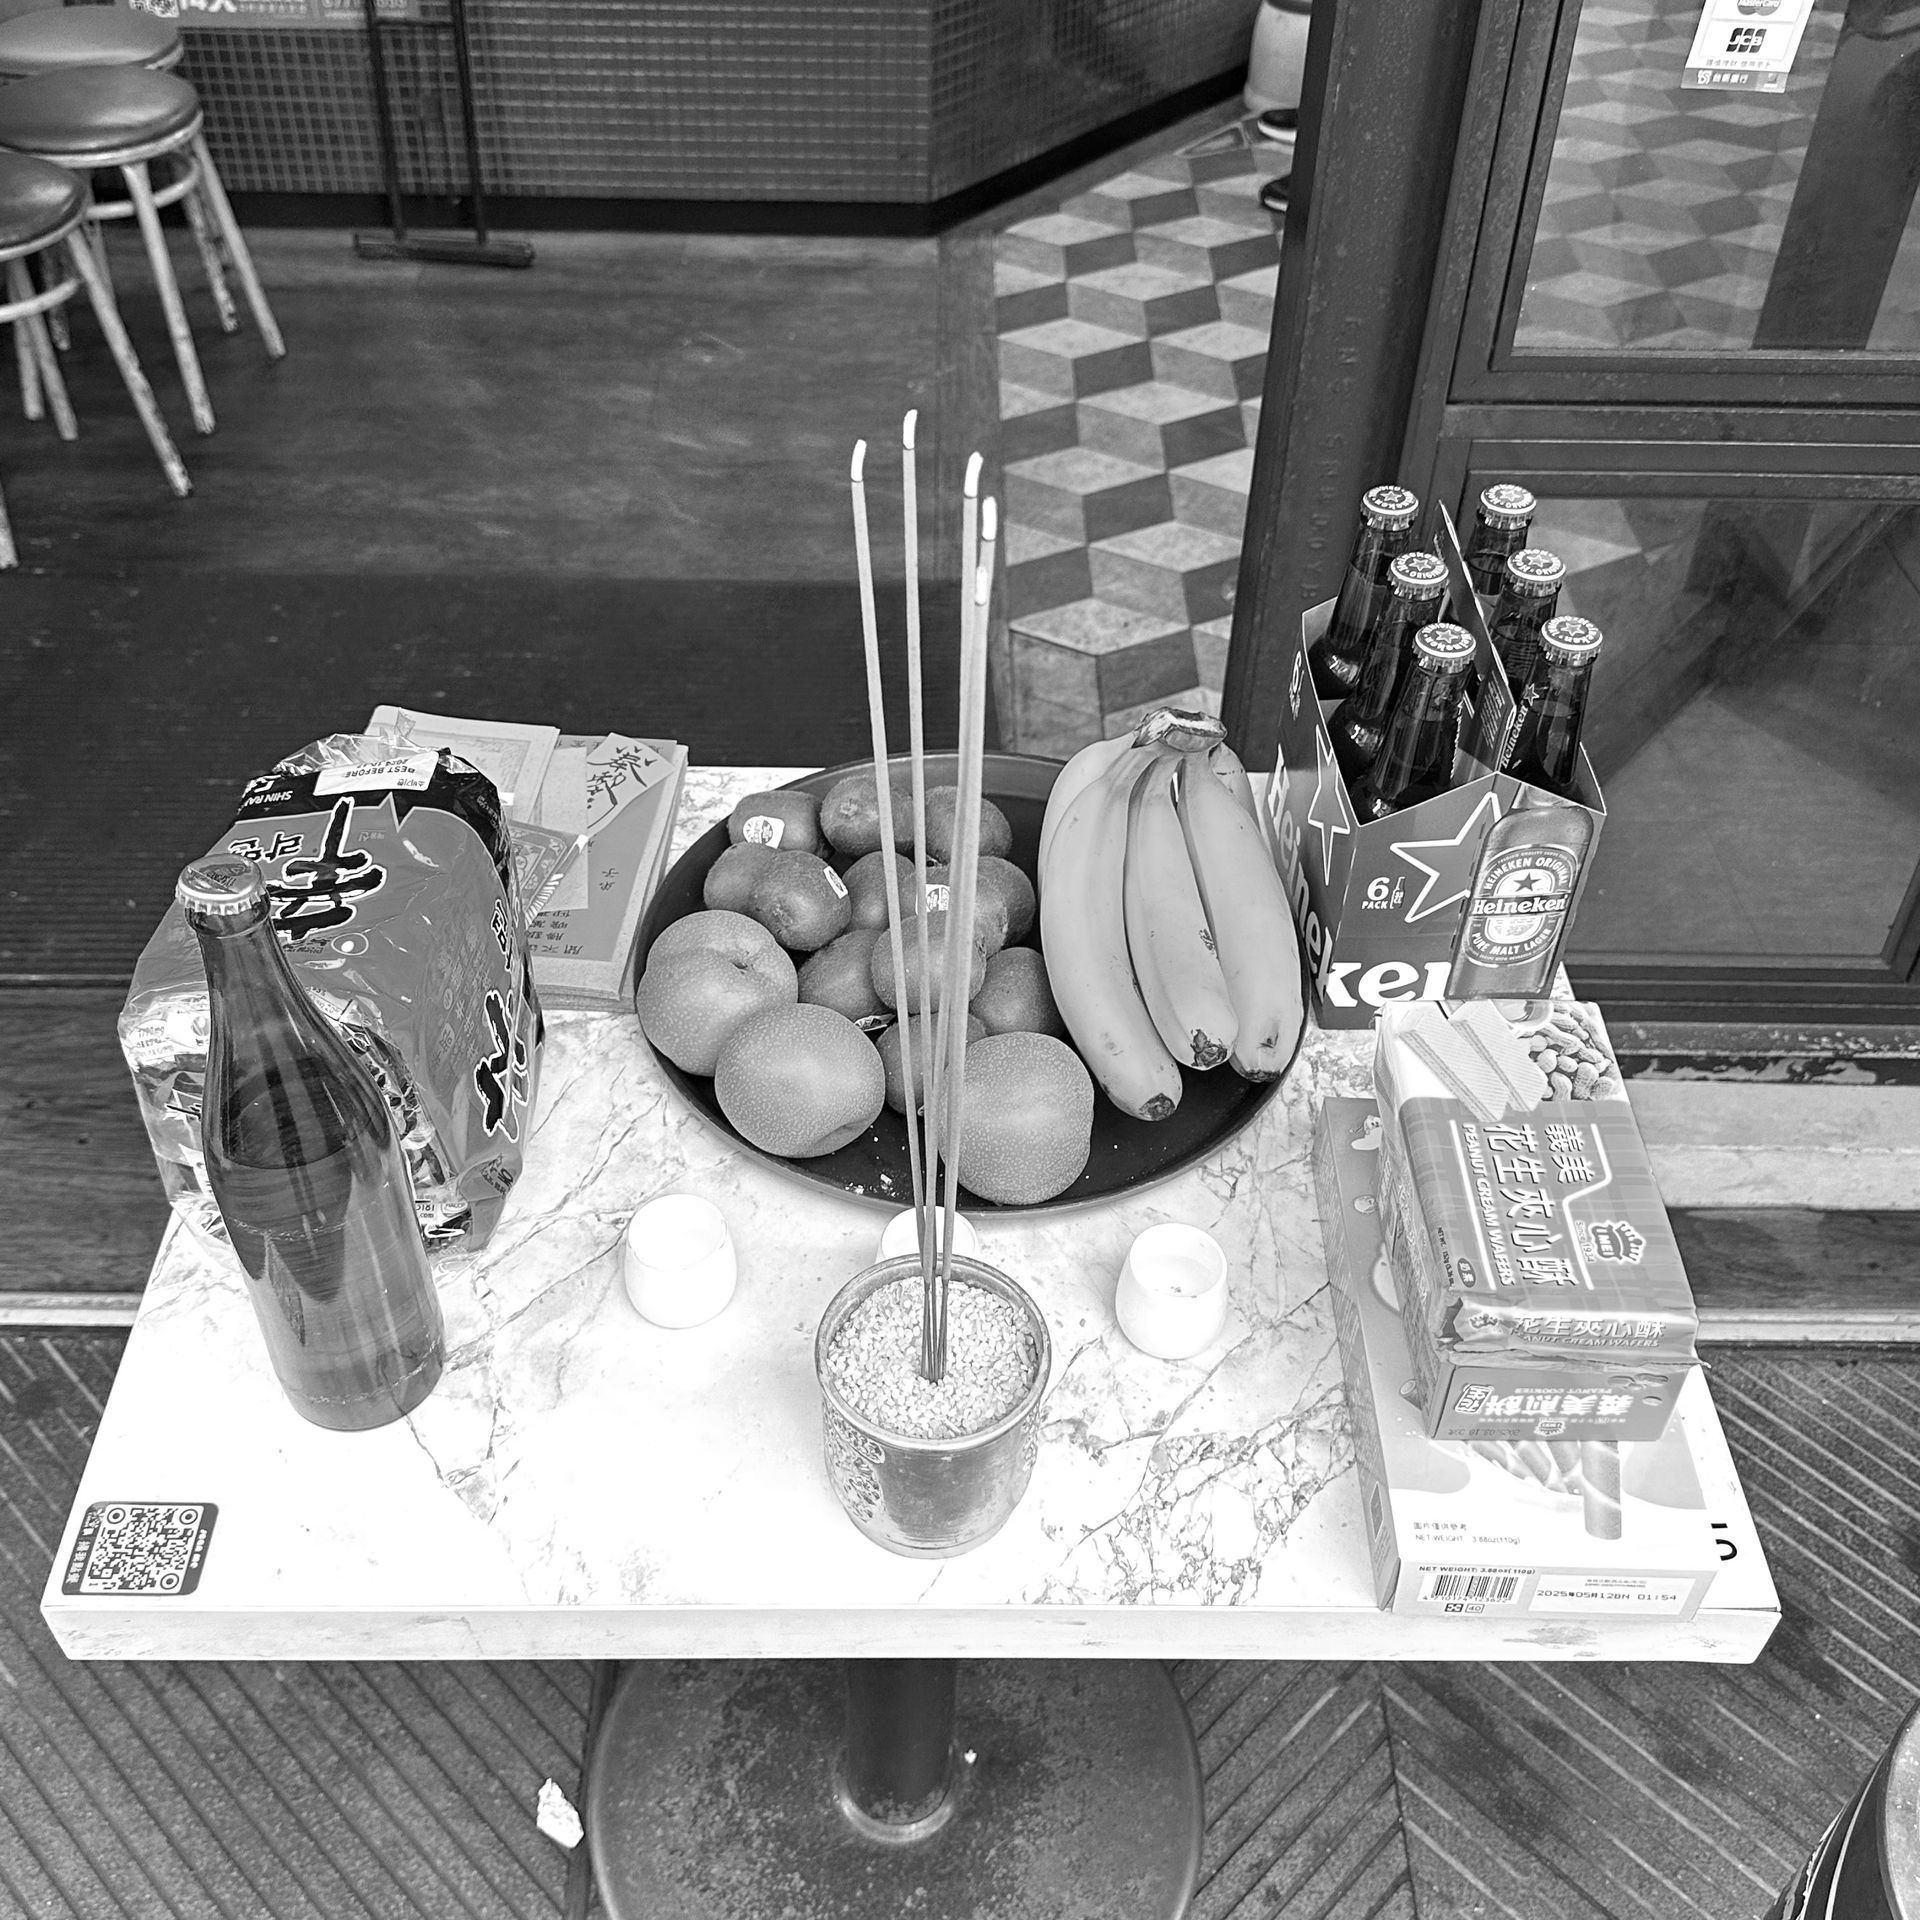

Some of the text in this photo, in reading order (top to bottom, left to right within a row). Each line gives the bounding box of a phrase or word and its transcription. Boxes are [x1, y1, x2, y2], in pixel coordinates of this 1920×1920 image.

[345, 766, 385, 778] BEFORE
[264, 790, 293, 803] SHIN
[1484, 857, 1568, 890] HEINEKEN ORIGINAL
[1366, 877, 1389, 900] 6
[1361, 900, 1389, 910] PACK
[1472, 894, 1568, 914] Heineken
[1472, 932, 1491, 953] PURE
[1489, 945, 1521, 955] MALT
[1524, 928, 1552, 950] LAGER
[1545, 1123, 1596, 1183] 義美
[1463, 1123, 1516, 1286] PEANUT CREAM WAFERS
[1484, 1123, 1579, 1285] 花生夾心酥
[1419, 1564, 1436, 1572] NET
